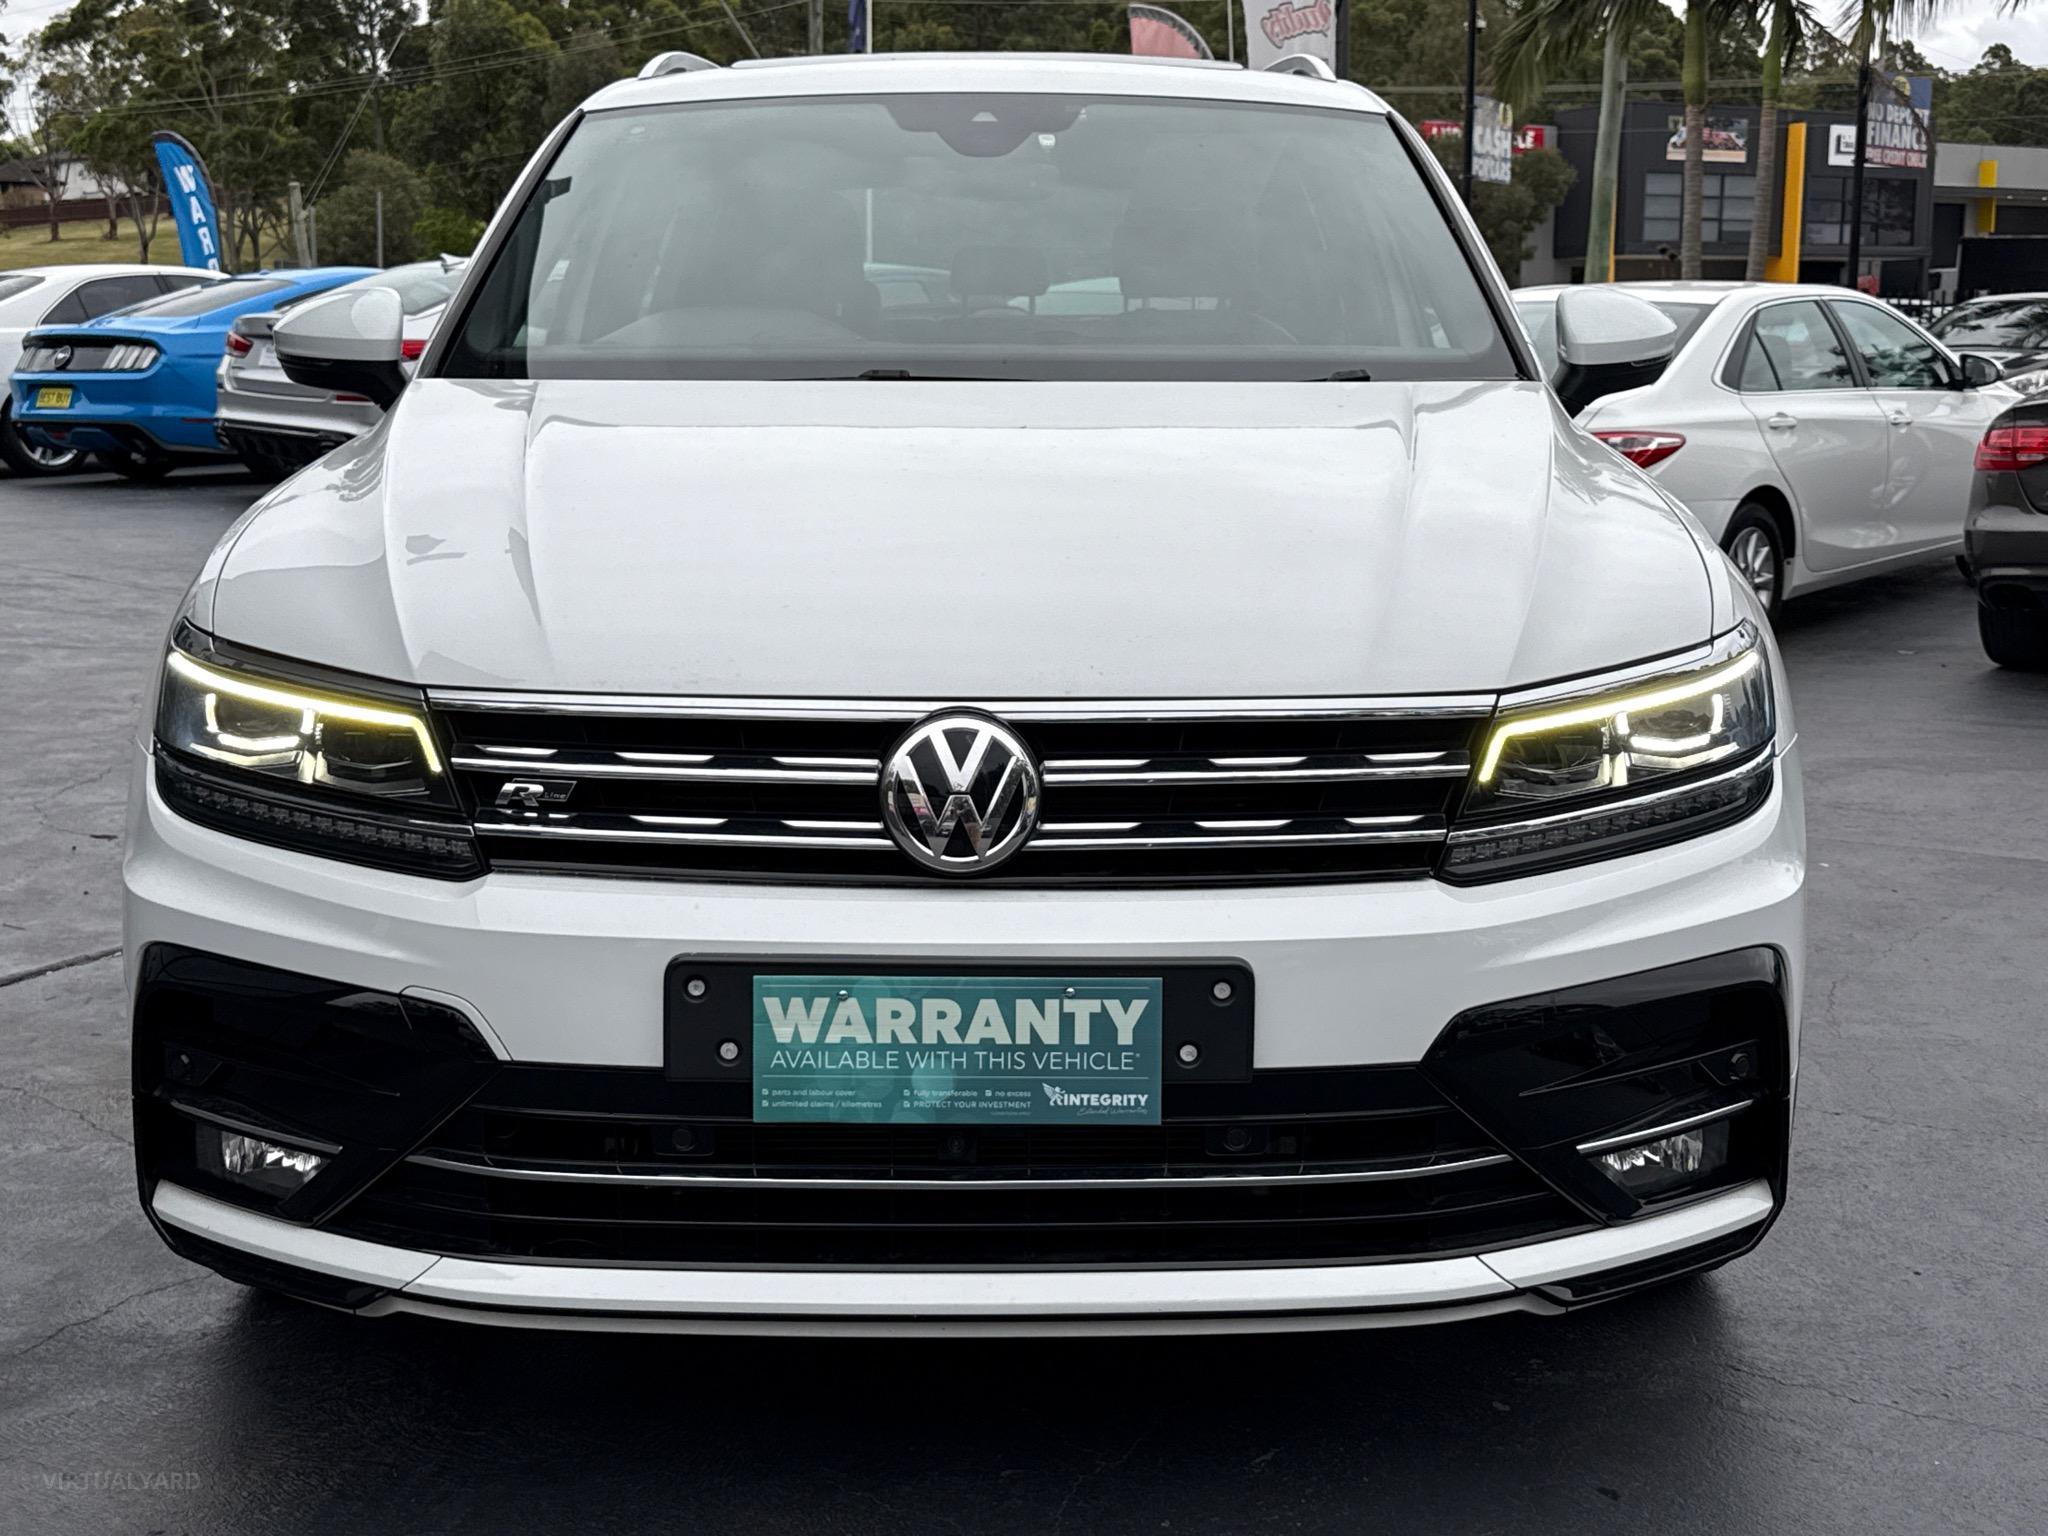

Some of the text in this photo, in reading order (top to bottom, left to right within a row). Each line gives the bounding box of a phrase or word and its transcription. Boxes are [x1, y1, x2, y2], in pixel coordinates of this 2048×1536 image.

[495, 783, 545, 807] R
[762, 997, 1149, 1045] WARRANTY
[770, 1051, 899, 1070] AVAILABLE
[906, 1051, 967, 1070] WITH
[974, 1051, 1026, 1071] THIS
[792, 1088, 808, 1096] and
[1063, 1094, 1149, 1106] INTEGRITY
[978, 1101, 1032, 1109] INVESTMENT
